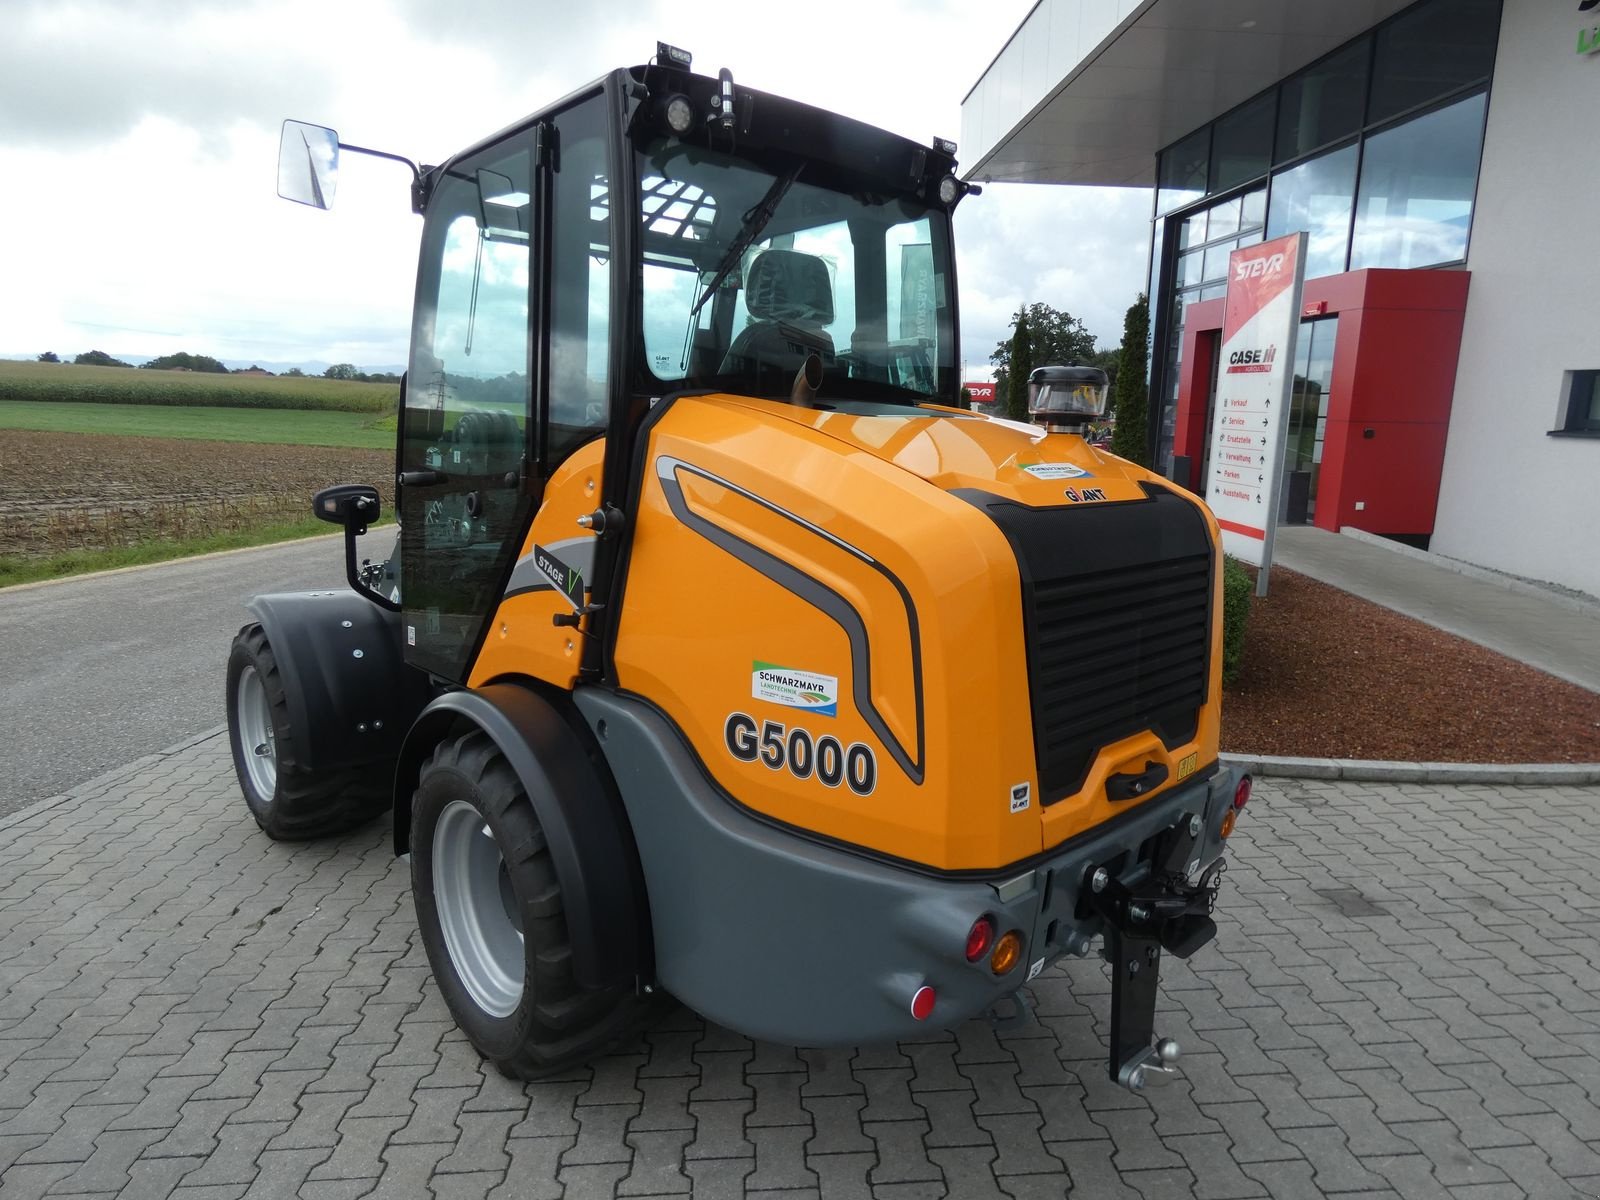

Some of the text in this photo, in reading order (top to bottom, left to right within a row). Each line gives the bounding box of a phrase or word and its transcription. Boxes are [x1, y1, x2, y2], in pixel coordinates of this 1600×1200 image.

[1235, 254, 1283, 281] STEYR
[1230, 350, 1262, 364] CASE
[1229, 417, 1245, 425] Service
[1227, 435, 1251, 444] Ersatzteile
[1226, 452, 1251, 464] Verwaltung
[1224, 470, 1240, 479] Parken
[1064, 486, 1107, 503] GIANT
[1223, 489, 1250, 501] Ausstellung
[538, 555, 583, 595] STAGE V
[759, 671, 825, 693] SCHWARZMAYR
[760, 681, 797, 695] LANDTECHNIK
[724, 712, 877, 796] G5000
